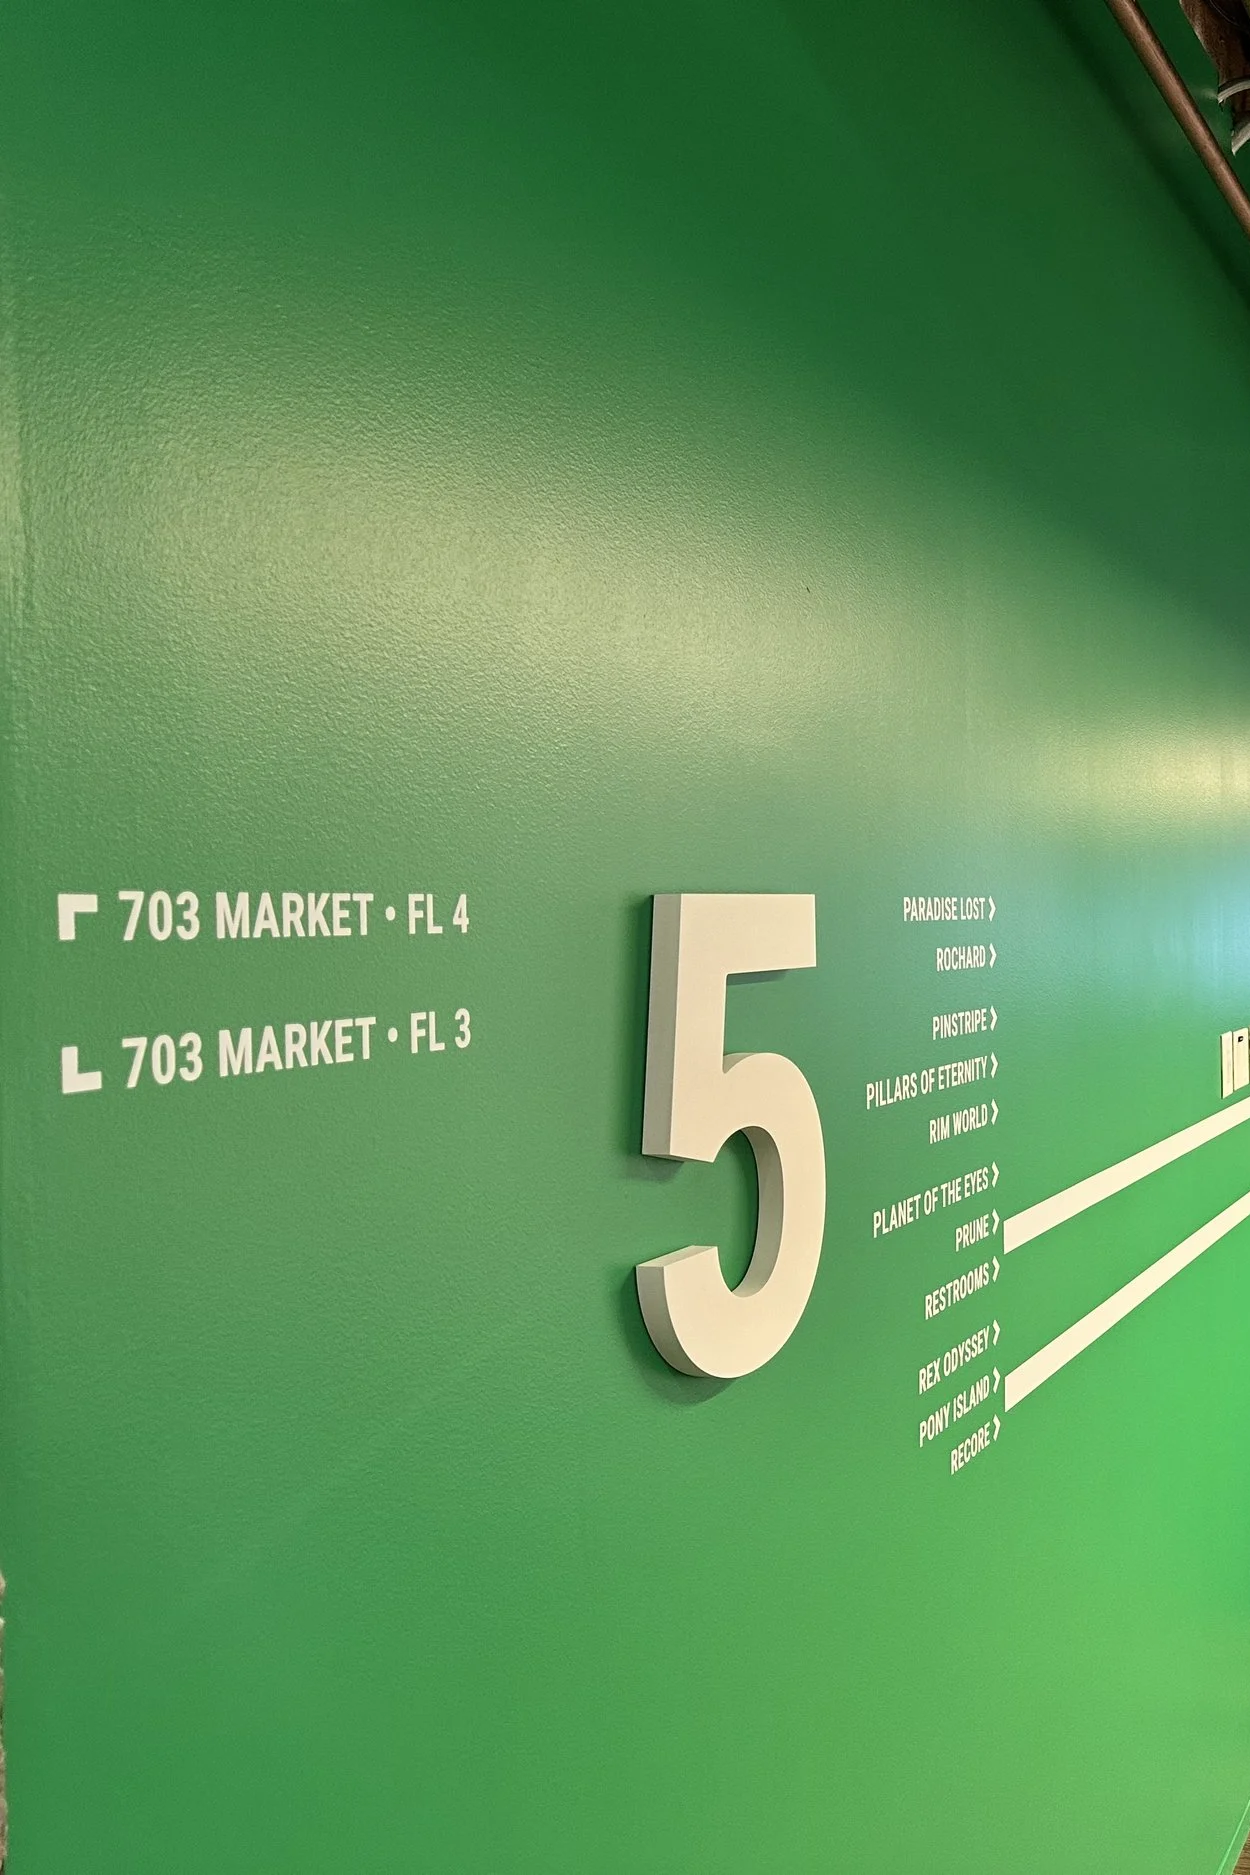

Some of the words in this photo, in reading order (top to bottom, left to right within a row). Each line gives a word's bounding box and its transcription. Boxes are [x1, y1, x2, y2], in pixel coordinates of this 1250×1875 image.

[118, 890, 200, 941] 703
[215, 891, 374, 939] MARKET
[408, 893, 443, 935] FL
[452, 893, 470, 934] 4
[903, 896, 958, 922] PARADISE
[960, 897, 986, 920] LOST
[936, 944, 986, 972] ROCHARD
[121, 1032, 203, 1089] 703
[218, 1016, 377, 1077] MARKET
[410, 1011, 446, 1054] FL
[454, 1007, 471, 1049] 3
[932, 1008, 987, 1041] PINSTRIPE
[866, 1073, 918, 1110] PILLARS
[920, 1067, 936, 1095] OF
[938, 1055, 988, 1090] ETERNITY
[636, 892, 827, 1379] 5
[929, 1114, 950, 1144] RIM
[952, 1103, 988, 1136] WORLD
[873, 1193, 922, 1238] PLANET
[923, 1186, 939, 1215] OF
[940, 1177, 962, 1208] THE
[964, 1166, 989, 1198] EYES
[955, 1213, 989, 1252] PRUNE
[925, 1262, 990, 1320] RESTROOMS
[919, 1357, 941, 1395] REX
[943, 1325, 990, 1377] ODYSSEY
[919, 1402, 951, 1448] PONY
[953, 1375, 990, 1422] ISLAND
[950, 1422, 991, 1475] RECORE
